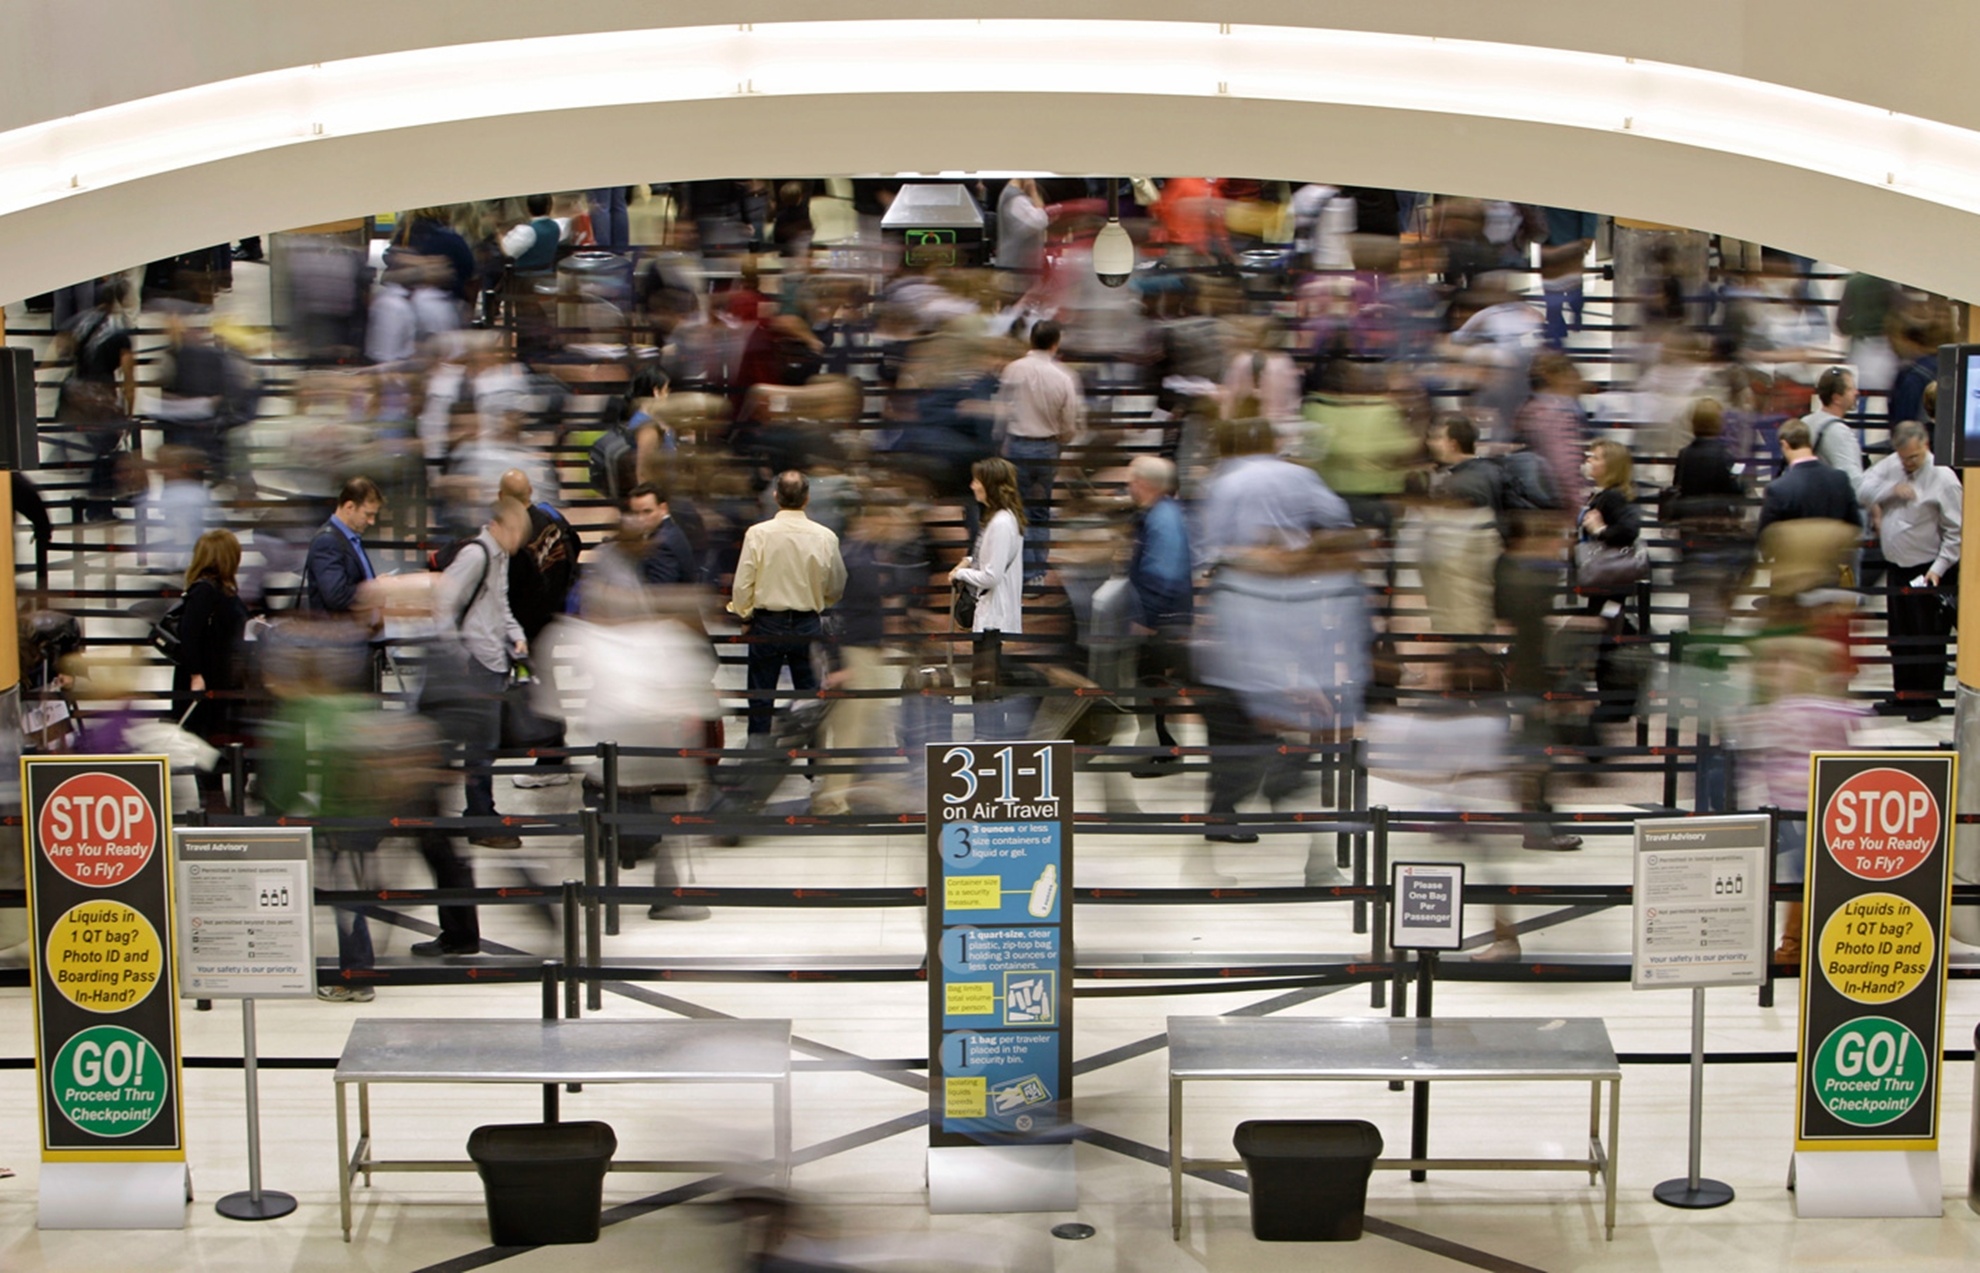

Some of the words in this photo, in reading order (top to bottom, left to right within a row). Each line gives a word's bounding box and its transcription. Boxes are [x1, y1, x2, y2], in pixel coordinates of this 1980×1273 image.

[942, 745, 1060, 804] 3-1-1
[942, 806, 967, 820] on
[972, 802, 999, 819] Air
[1003, 801, 1059, 818] Travel
[1834, 790, 1930, 835] STOP
[50, 795, 145, 841] STOP
[1030, 825, 1049, 833] less
[953, 827, 972, 859] 3
[972, 837, 990, 845] size
[992, 836, 1041, 845] containers
[1042, 836, 1052, 844] of
[1645, 834, 1669, 842] Travel
[1671, 833, 1706, 841] Advisory
[1831, 837, 1855, 850] Are
[1859, 837, 1884, 850] You
[1887, 836, 1930, 853] Ready
[49, 843, 74, 856] Are
[77, 842, 102, 856] You
[105, 842, 149, 859] Ready
[212, 844, 248, 852] Advisory
[972, 849, 997, 859] liquid
[1010, 848, 1027, 859] gel.
[75, 862, 92, 877] To
[94, 862, 124, 879] Fly?
[1856, 856, 1872, 870] To
[1874, 856, 1905, 873] Fly?
[946, 879, 982, 887] Container
[984, 878, 998, 886] size
[1414, 881, 1443, 889] Please
[1408, 892, 1427, 900] One
[1429, 892, 1447, 902] Bag
[1420, 902, 1436, 910] Per
[1845, 903, 1895, 918] Liquids
[1898, 903, 1911, 916] in
[69, 910, 119, 926] Liquids
[122, 910, 135, 923] in
[1404, 912, 1451, 923] Passenger
[1028, 930, 1051, 938] clear
[1846, 922, 1853, 935] 1
[1857, 922, 1877, 936] QT
[1880, 922, 1914, 938] bag?
[71, 930, 78, 943] 1
[82, 930, 102, 944] QT
[105, 930, 139, 946] bag?
[958, 933, 969, 964] 1
[1002, 941, 1033, 951] zip-top
[1835, 942, 1875, 955] Photo
[1878, 942, 1893, 955] ID
[1896, 942, 1922, 955] and
[62, 950, 102, 962] Photo
[106, 950, 120, 962] ID
[124, 950, 149, 962] and
[968, 952, 1002, 961] holding
[217, 966, 241, 974] safety
[266, 966, 297, 974] priority
[968, 962, 987, 970] less
[988, 962, 1039, 970] containers.
[1828, 961, 1890, 977] Boarding
[1893, 961, 1926, 974] Pass
[58, 970, 119, 986] Boarding
[122, 970, 156, 983] Pass
[1844, 980, 1905, 994] In-Hand?
[75, 989, 136, 1003] In-Hand?
[970, 1036, 977, 1044] 1
[979, 1036, 997, 1045] bag
[998, 1036, 1014, 1045] per
[1016, 1035, 1051, 1043] traveler
[958, 1038, 969, 1069] 1
[970, 1046, 1000, 1055] placed
[1012, 1045, 1028, 1054] the
[1835, 1030, 1910, 1077] GO!
[72, 1040, 146, 1087] GO!
[970, 1056, 1005, 1065] security
[1824, 1078, 1881, 1092] Proceed
[1884, 1078, 1915, 1091] Thru
[65, 1088, 121, 1102] Proceed
[124, 1088, 155, 1101] Thru
[1828, 1097, 1910, 1114] Checkpoint!
[71, 1108, 152, 1124] Checkpoint!
